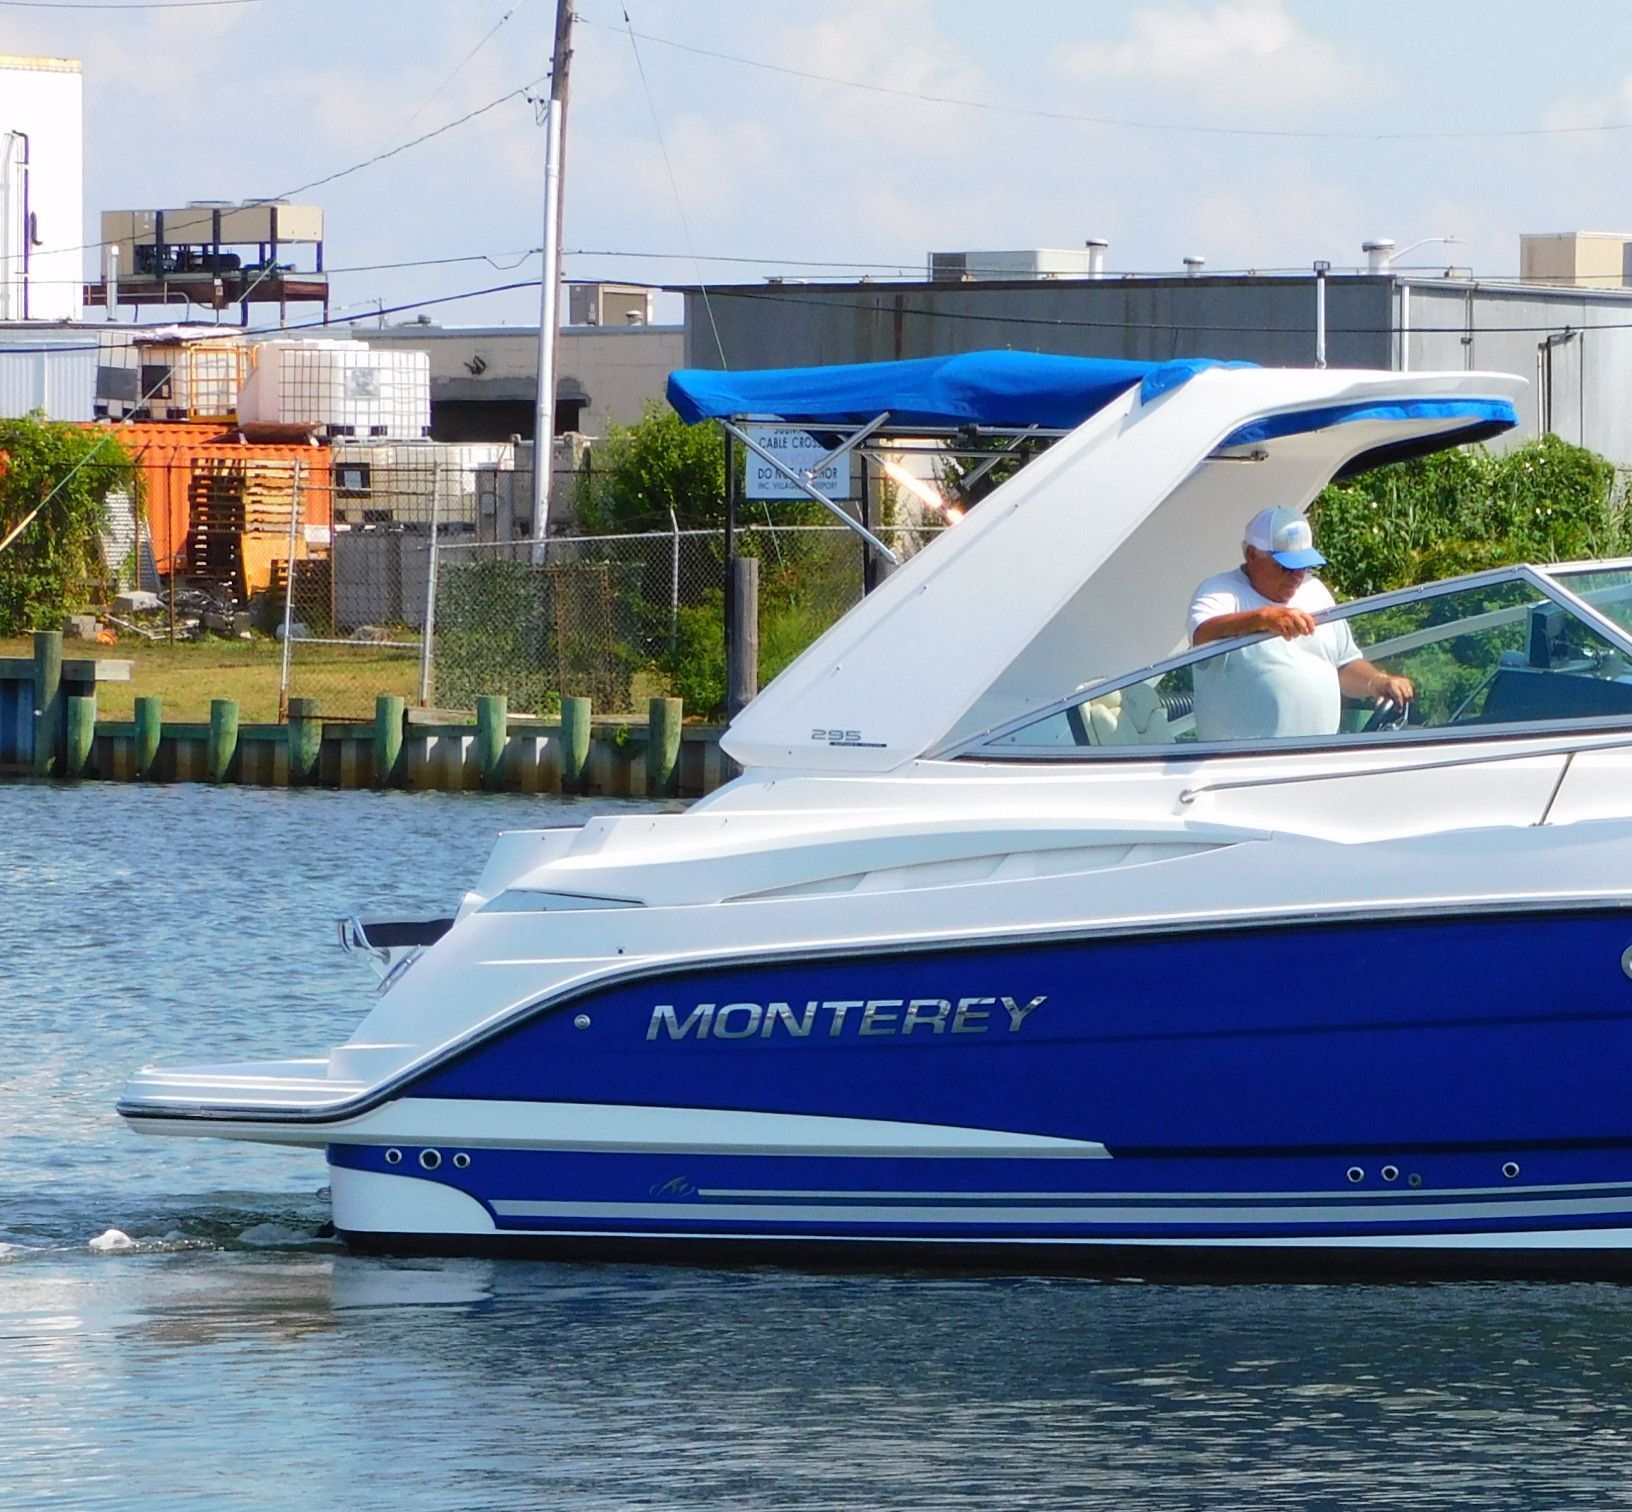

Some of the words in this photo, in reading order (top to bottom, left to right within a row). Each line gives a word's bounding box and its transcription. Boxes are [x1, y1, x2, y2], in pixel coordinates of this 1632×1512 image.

[758, 436, 787, 449] CABLE
[758, 467, 773, 480] DO
[811, 728, 862, 741] 295
[645, 995, 1049, 1041] MONTEREY
